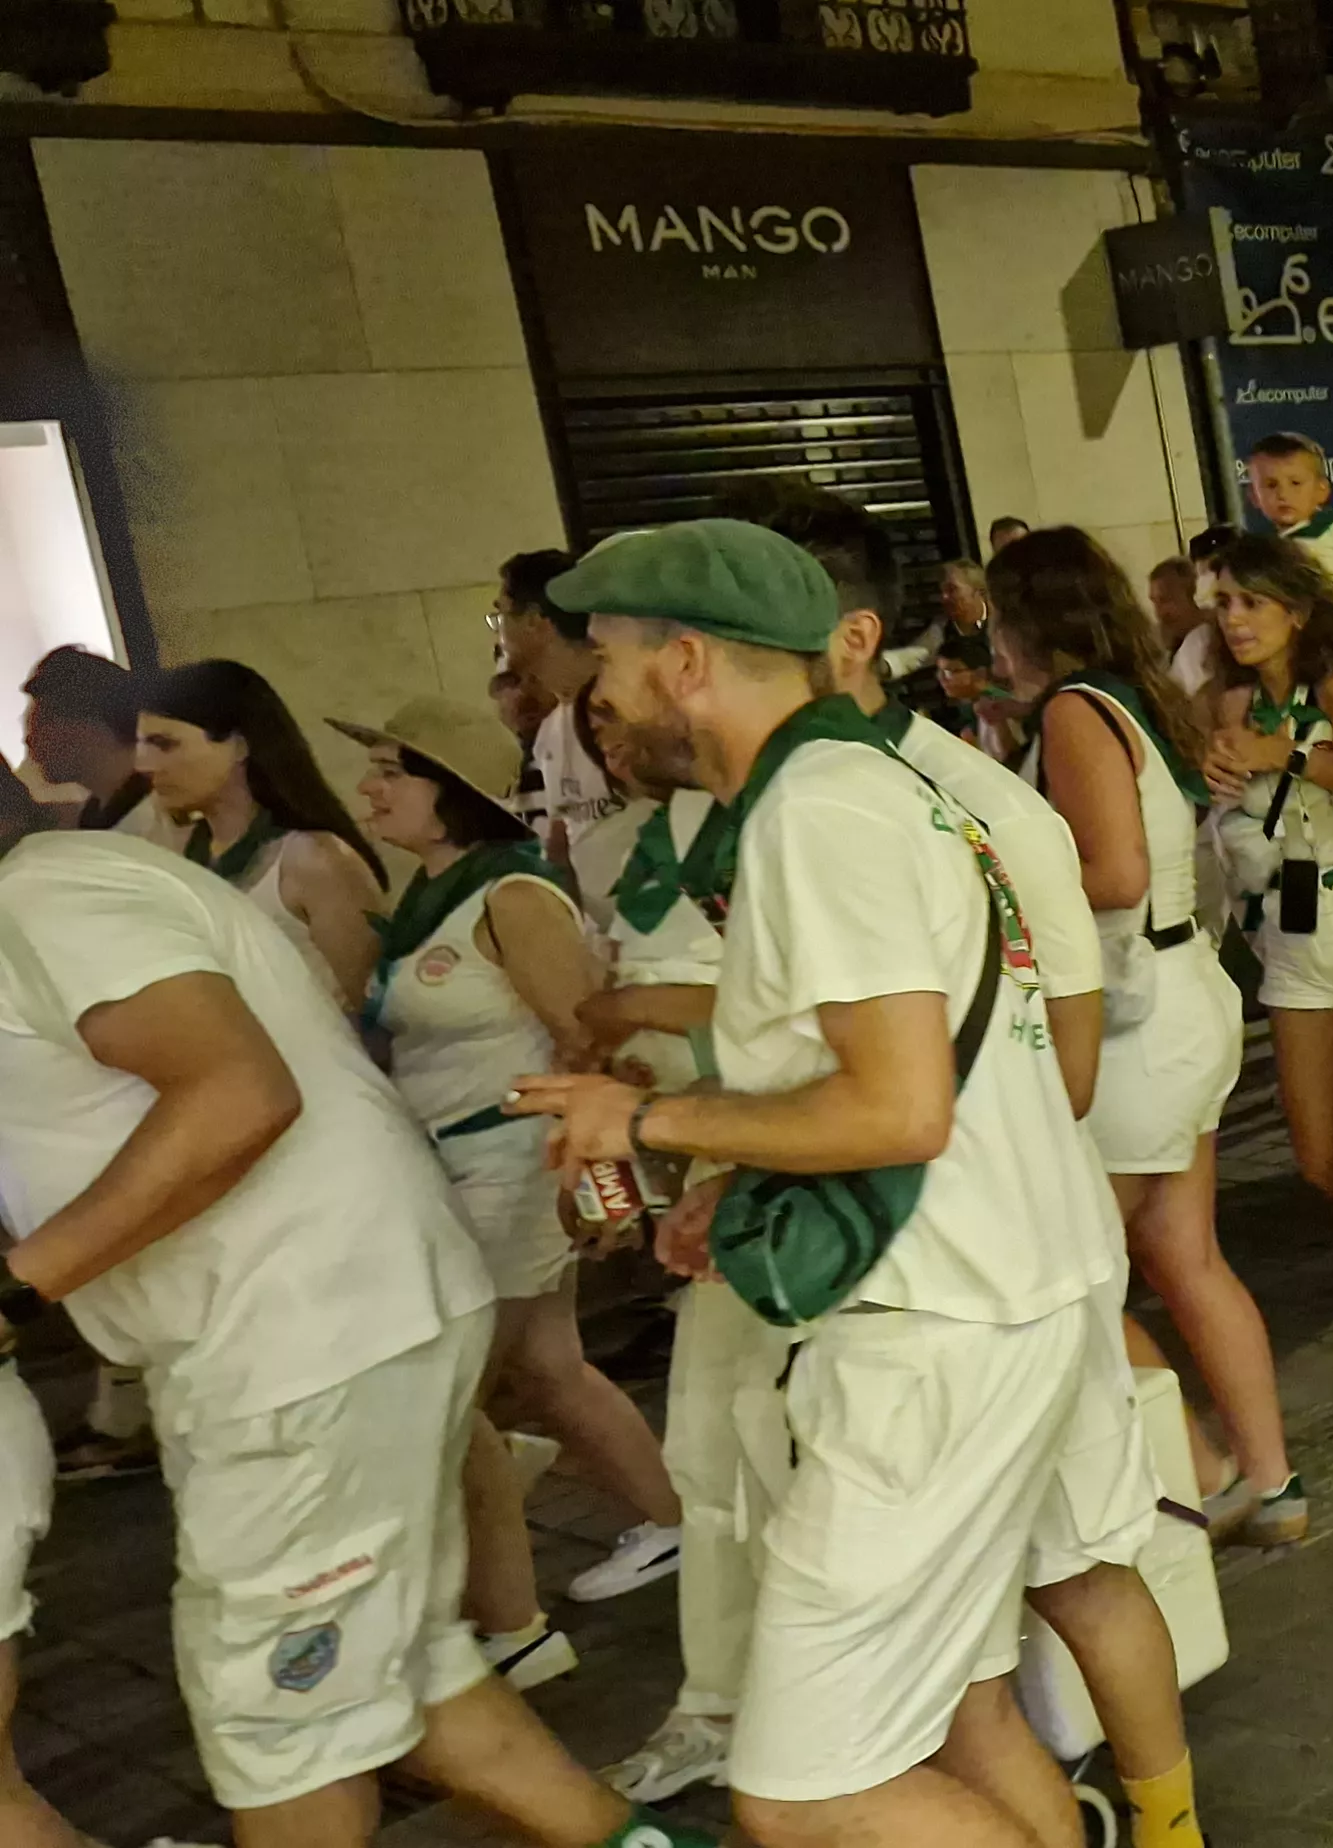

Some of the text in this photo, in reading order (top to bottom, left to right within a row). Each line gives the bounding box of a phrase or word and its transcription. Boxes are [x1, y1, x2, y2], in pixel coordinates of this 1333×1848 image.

[584, 203, 851, 253] MANGO
[702, 263, 758, 280] MAN
[1117, 252, 1213, 296] MANGO
